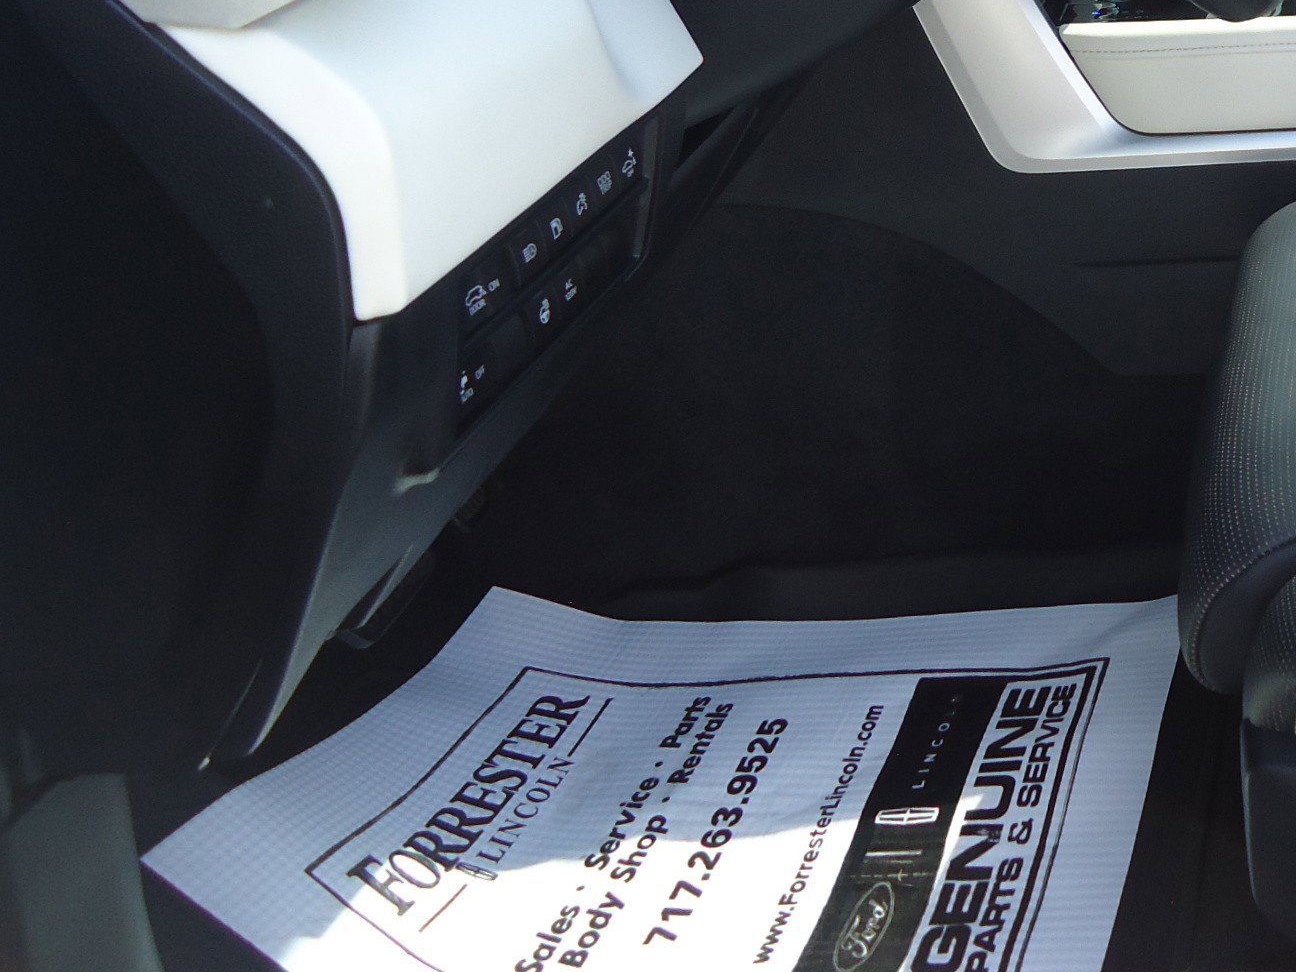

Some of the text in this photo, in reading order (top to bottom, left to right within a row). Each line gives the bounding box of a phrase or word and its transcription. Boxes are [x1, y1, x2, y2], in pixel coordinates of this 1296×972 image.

[347, 695, 591, 916] FORRESTER
[476, 756, 575, 864] LINCOLN
[514, 696, 711, 972] Sales Service Parts
[558, 702, 734, 968] Body Shop Rentals
[642, 717, 788, 945] 717.263.9525
[752, 704, 884, 964] www.ForresterLincoln.com
[911, 686, 1052, 972] GENUINE
[912, 693, 961, 789] LINCO
[964, 683, 1077, 972] PARTS & SERVICE
[841, 899, 889, 959] Ford
